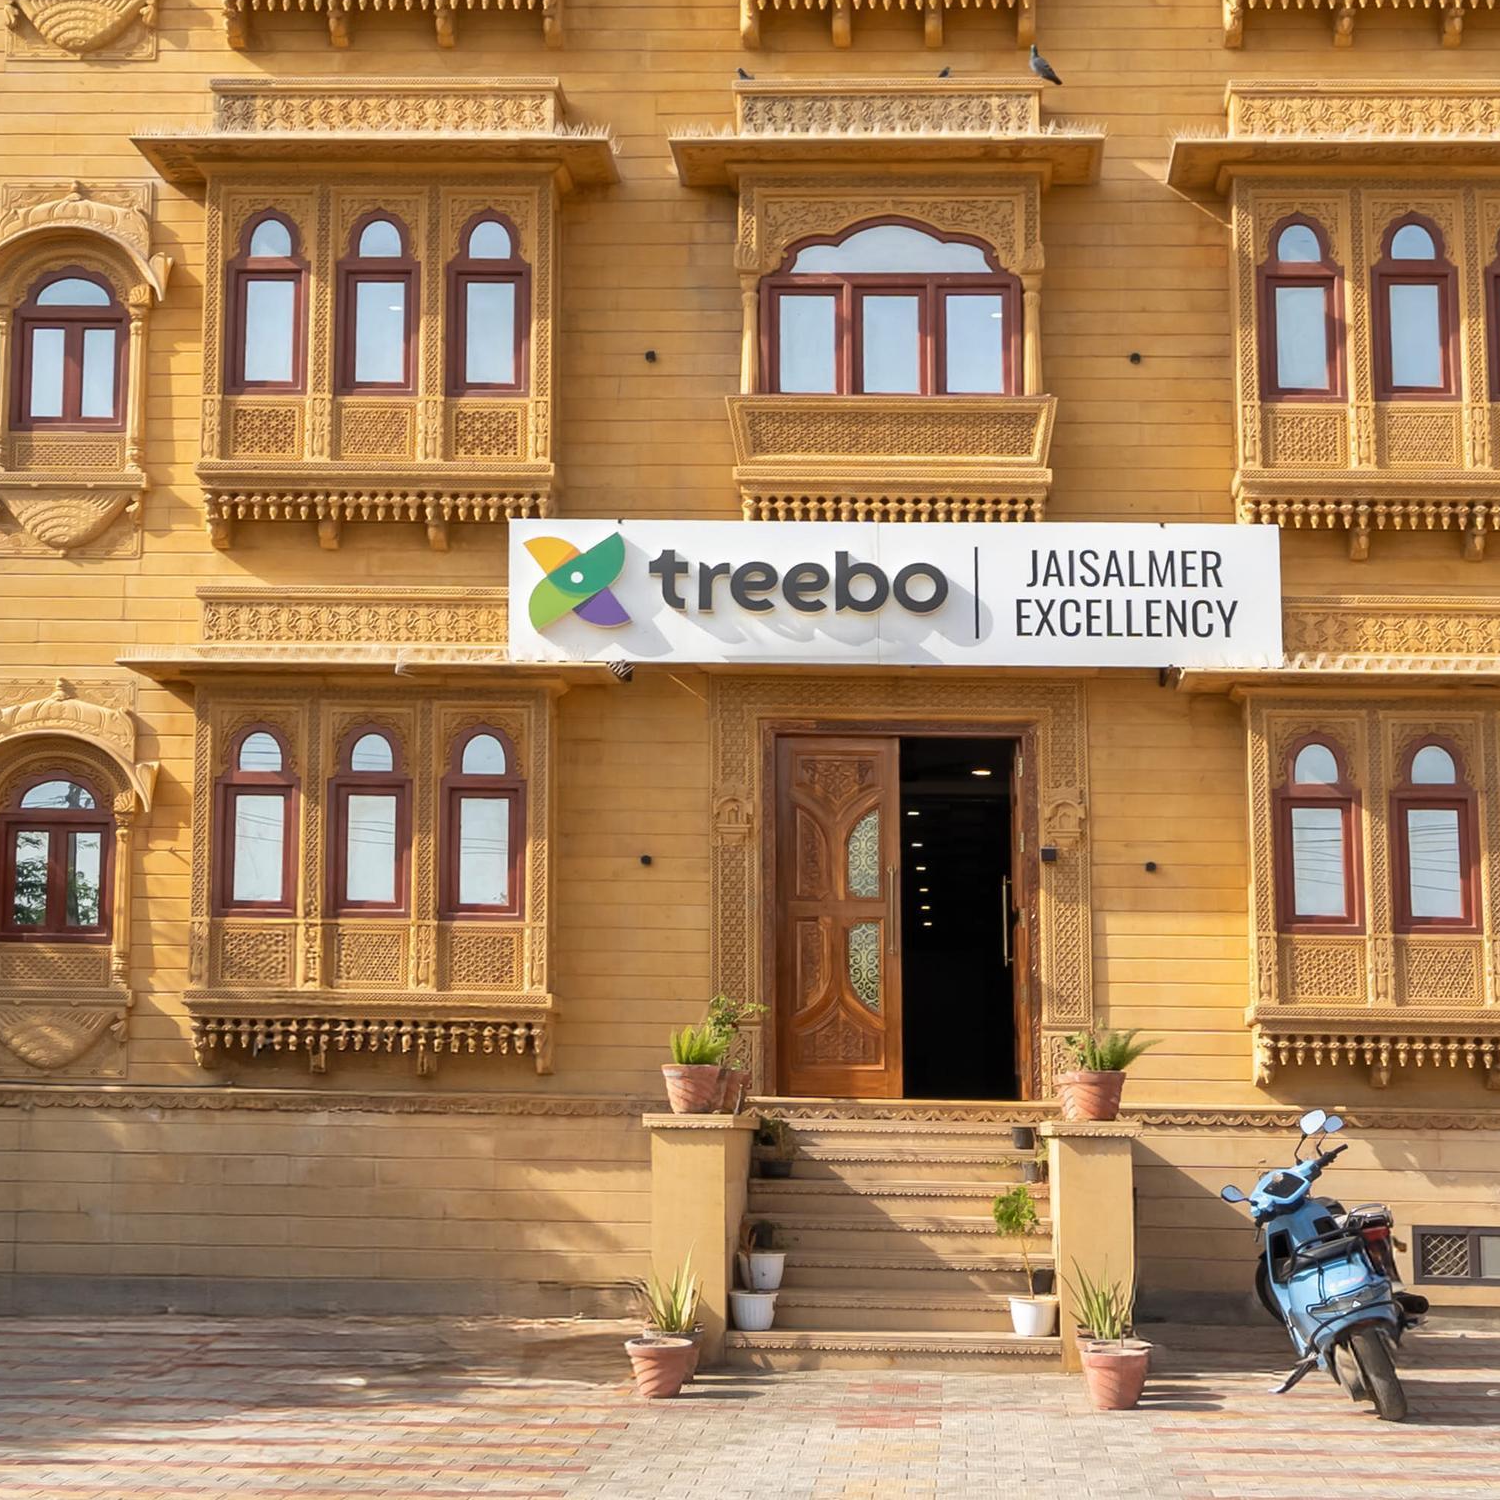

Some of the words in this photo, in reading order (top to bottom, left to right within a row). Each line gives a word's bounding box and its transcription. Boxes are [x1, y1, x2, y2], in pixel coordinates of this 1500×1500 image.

[649, 550, 948, 614] treebo
[1026, 550, 1222, 588] JAISALMER
[1016, 599, 1237, 638] EXCELLENCY
